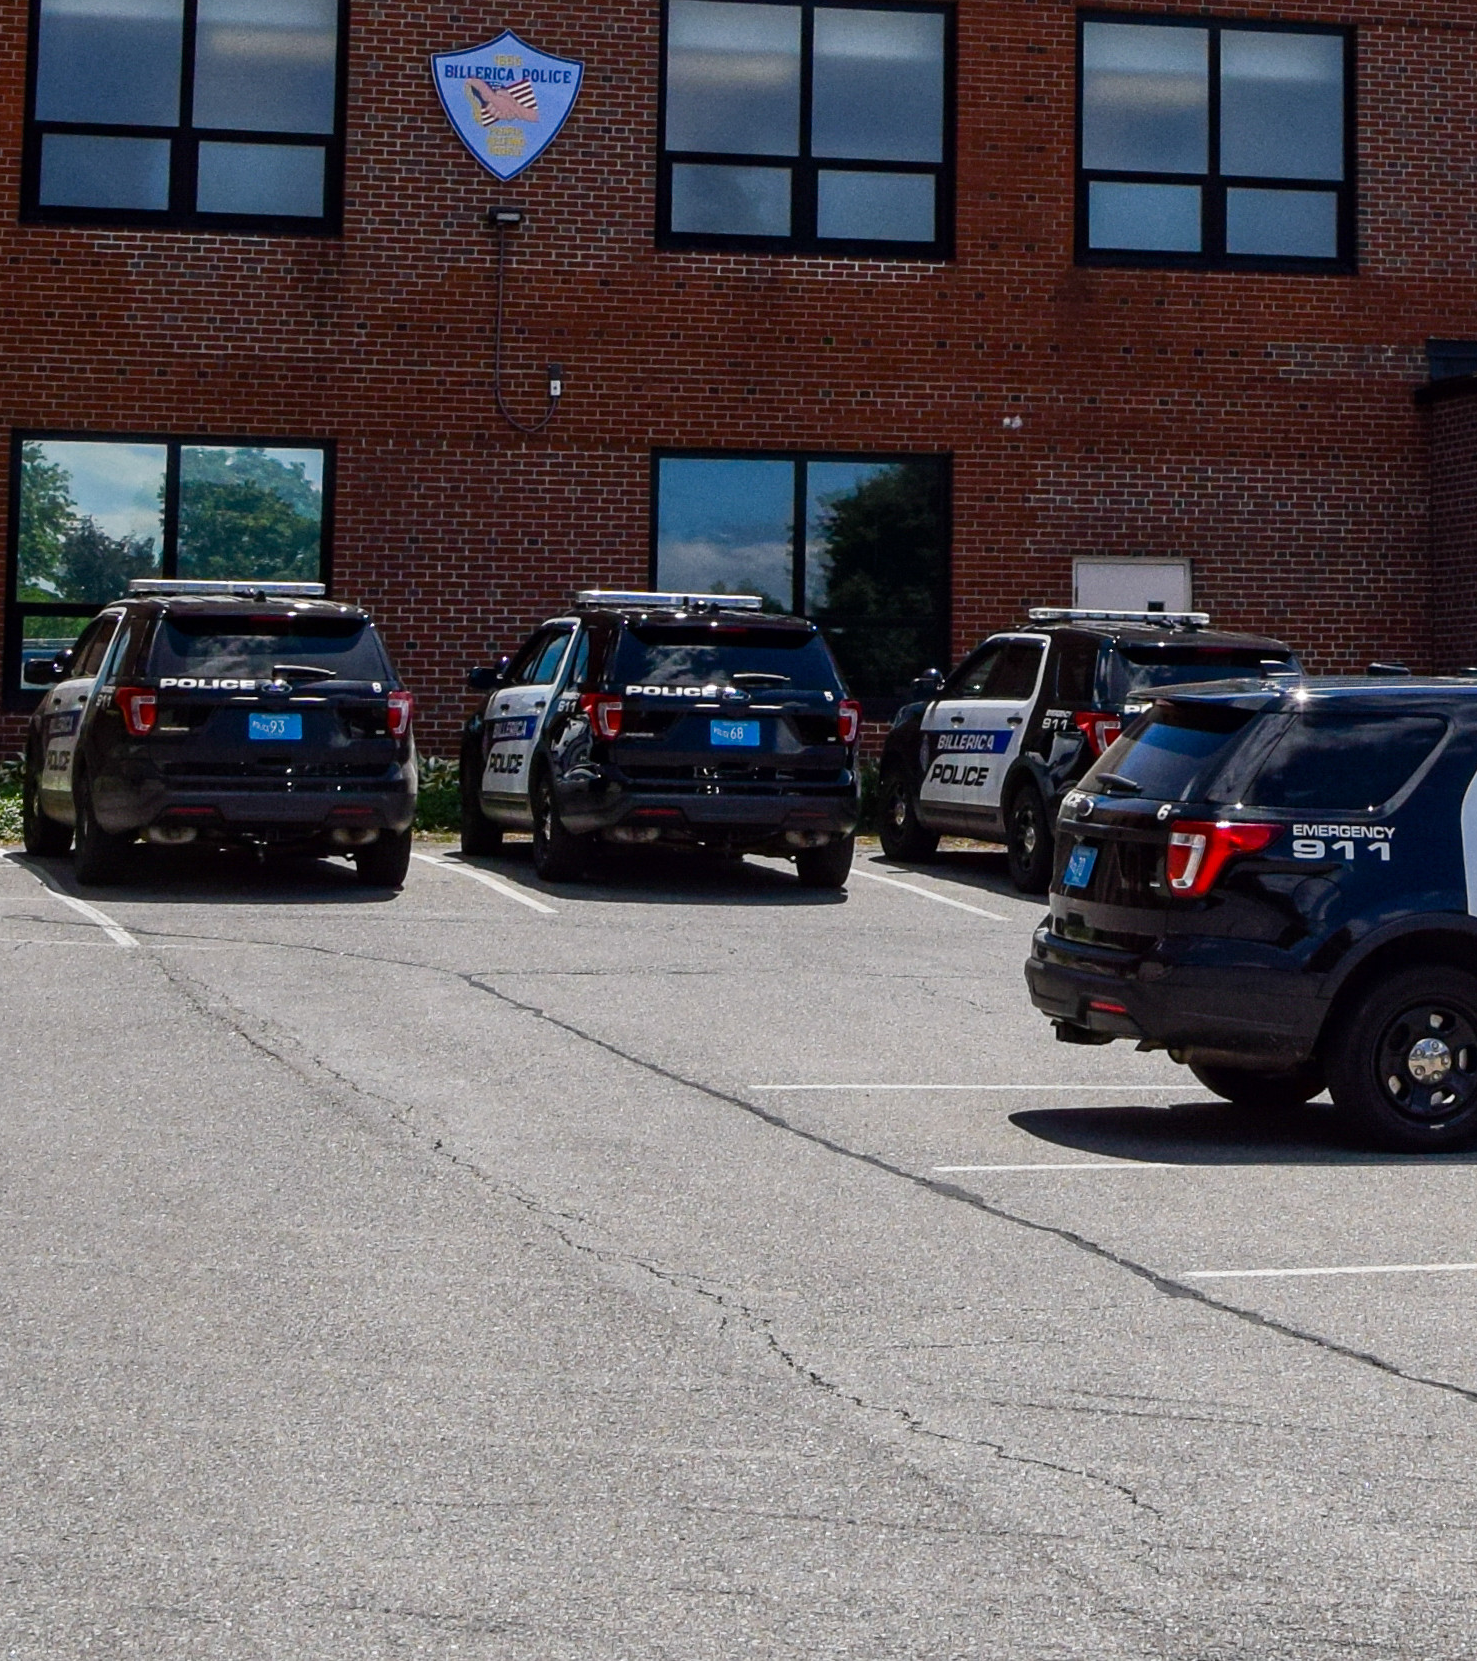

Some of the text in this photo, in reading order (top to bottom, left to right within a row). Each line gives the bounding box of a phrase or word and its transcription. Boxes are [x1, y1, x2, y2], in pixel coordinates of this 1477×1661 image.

[444, 64, 572, 83] BILLERICA POLICE
[159, 678, 256, 689] POLICE
[625, 685, 717, 698] POLICE
[269, 719, 285, 734] 93
[1041, 718, 1070, 731] 911
[730, 726, 744, 740] 68
[936, 734, 994, 751] BILLERICA
[930, 764, 989, 787] POLICE
[1157, 804, 1172, 821] 6
[1292, 824, 1396, 839] EMERGENCY
[1292, 839, 1391, 861] 911
